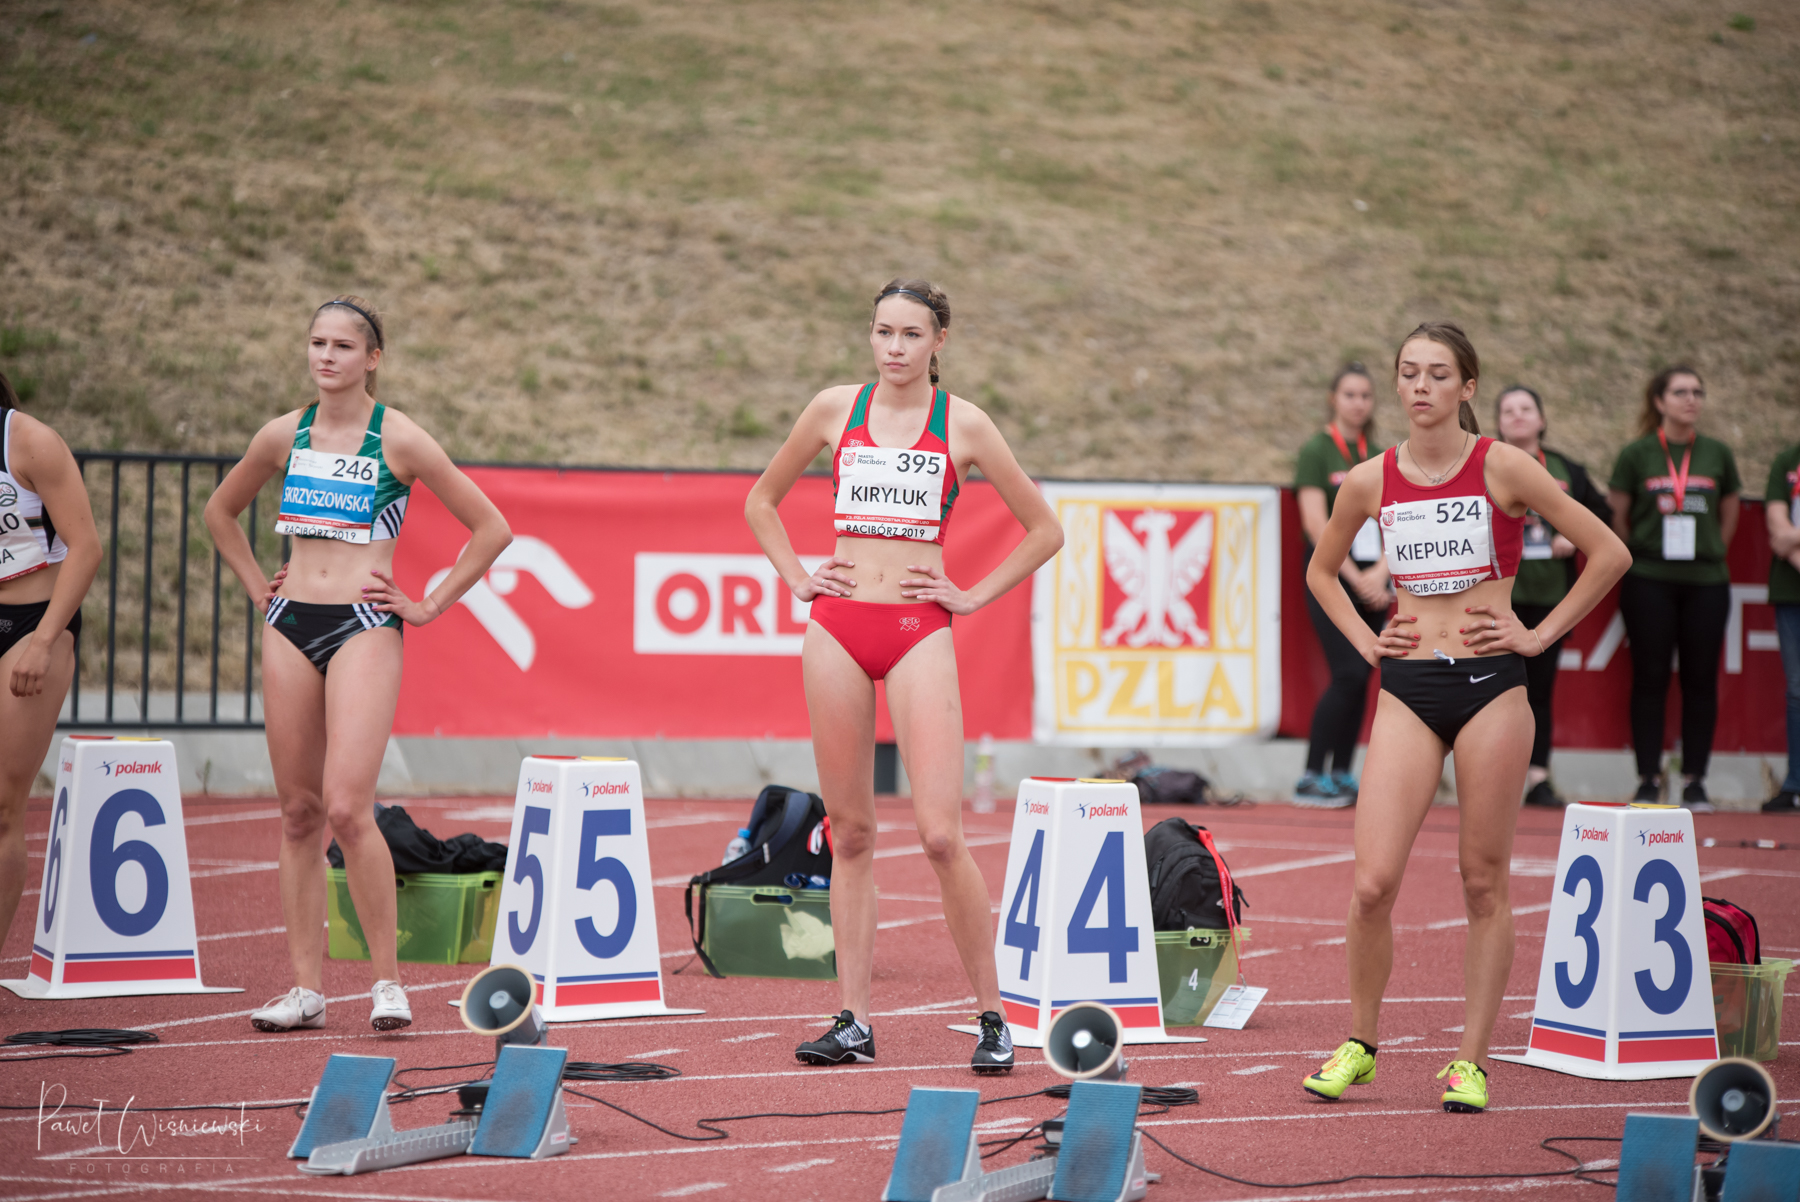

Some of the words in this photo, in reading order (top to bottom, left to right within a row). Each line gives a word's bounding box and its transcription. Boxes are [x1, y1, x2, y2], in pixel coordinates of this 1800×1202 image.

[332, 458, 373, 481] 246
[858, 458, 887, 466] Racibórz
[896, 453, 940, 475] 395
[284, 486, 370, 513] SKRZYSZOWSKA
[850, 485, 928, 507] KIRYLUK
[1397, 514, 1426, 522] Racibórz
[1436, 500, 1482, 524] 524
[284, 525, 329, 537] RACIBÓRZ
[331, 530, 356, 540] 2019
[846, 523, 899, 536] RACIBÓRZ
[901, 527, 925, 538] 2019
[1396, 538, 1474, 562] KIEPURA
[1452, 578, 1478, 590] 2019
[1066, 660, 1243, 719] PZLA
[115, 760, 163, 777] polanik
[531, 779, 554, 794] polanik
[592, 781, 630, 799] polanik
[1029, 801, 1050, 815] polanik
[1089, 803, 1129, 820] polanik
[1581, 827, 1609, 842] polanik
[1648, 829, 1684, 847] polanik
[43, 786, 68, 934] 6
[89, 788, 169, 937] 6
[508, 805, 551, 956] 5
[574, 808, 637, 960] 5
[1004, 828, 1045, 982] 4
[1067, 831, 1140, 984] 4
[1554, 854, 1604, 1010] 3
[1633, 858, 1693, 1016] 3
[1188, 968, 1199, 991] 4
